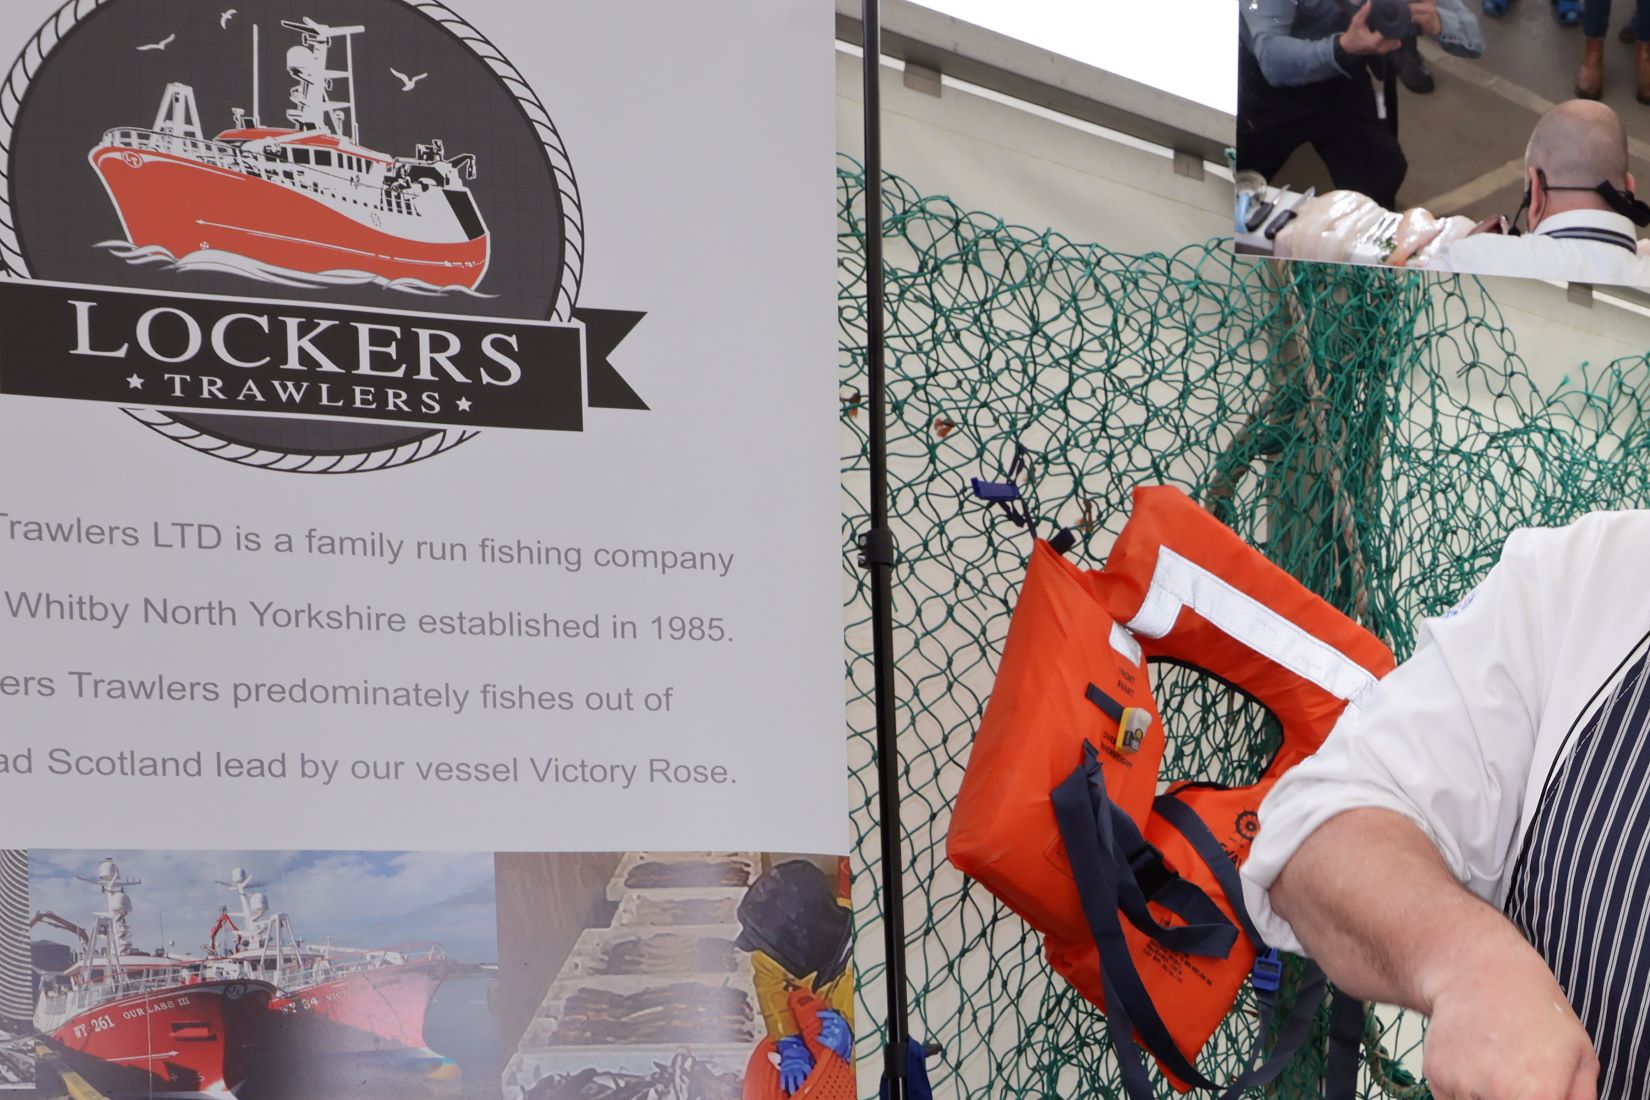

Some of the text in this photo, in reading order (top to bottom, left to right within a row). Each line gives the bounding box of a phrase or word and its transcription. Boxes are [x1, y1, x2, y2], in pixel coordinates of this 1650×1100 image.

[67, 299, 522, 387] LOCKERS
[164, 373, 441, 414] TRAWLERS
[153, 521, 222, 550] LTD
[235, 524, 262, 552] is
[273, 533, 294, 553] a
[304, 527, 405, 565] family
[416, 540, 467, 562] run
[478, 537, 582, 573] fishing
[593, 548, 735, 578] company
[3, 590, 734, 643] Whitby North Yorkshire established in 1985.
[67, 670, 220, 702] Trawlers
[232, 677, 470, 715] predominately
[479, 683, 574, 711] fishes
[585, 687, 635, 712] out
[644, 686, 674, 712] of
[47, 747, 202, 778] Scotland
[215, 751, 287, 779] lead
[300, 752, 339, 786] by
[350, 760, 406, 780] our
[415, 756, 518, 783] vessel
[529, 757, 638, 790] Victory
[649, 758, 737, 784] Rose.
[90, 1015, 115, 1033] 261
[123, 1008, 145, 1020] OUR
